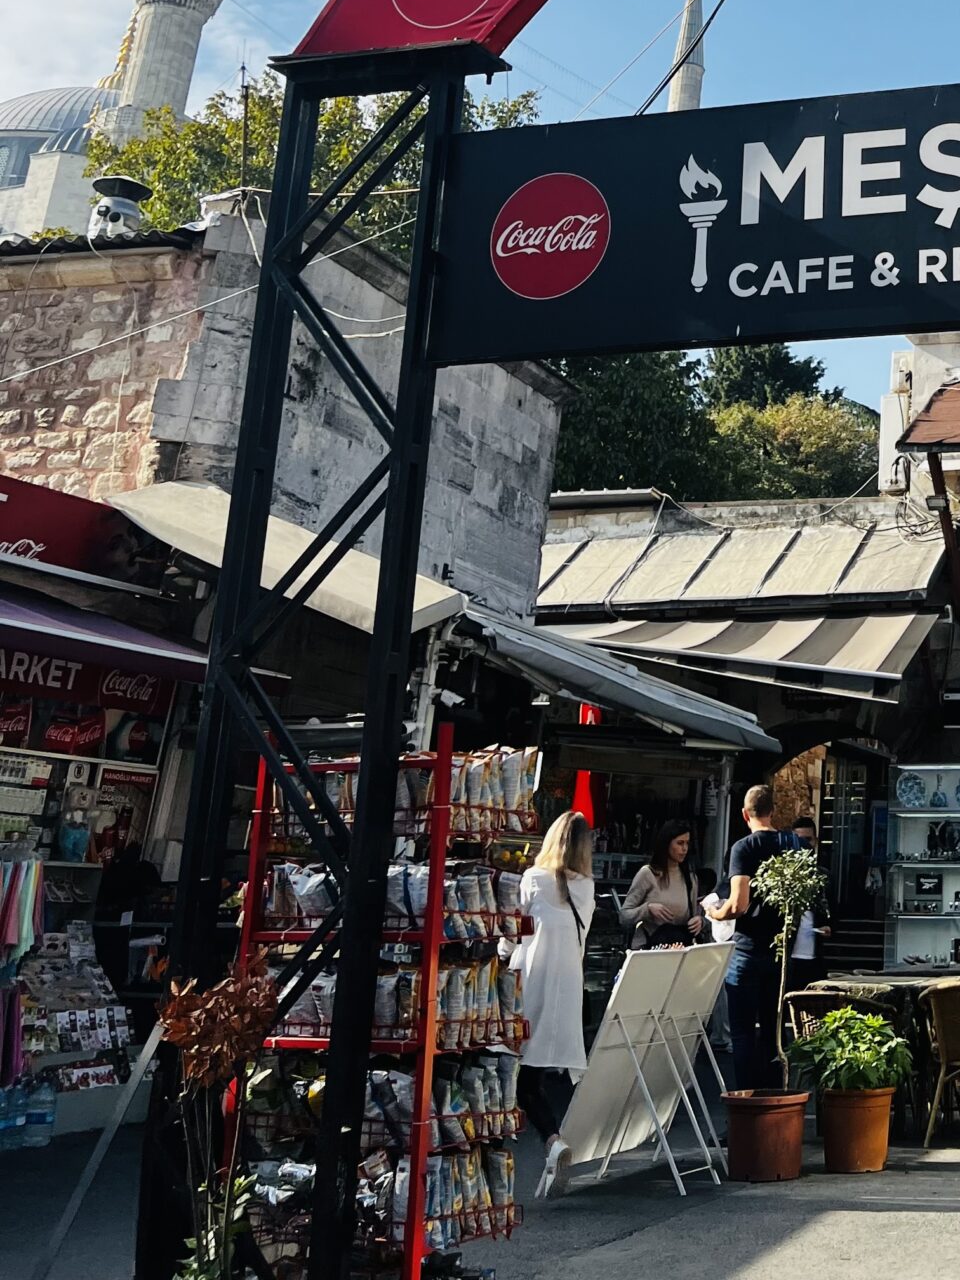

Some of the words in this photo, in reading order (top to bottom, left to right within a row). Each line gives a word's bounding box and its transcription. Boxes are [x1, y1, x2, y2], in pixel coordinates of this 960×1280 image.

[496, 213, 605, 257] Coca-Cola
[728, 255, 854, 298] CAFE
[870, 251, 900, 287] &
[102, 669, 157, 701] Coca-Cola
